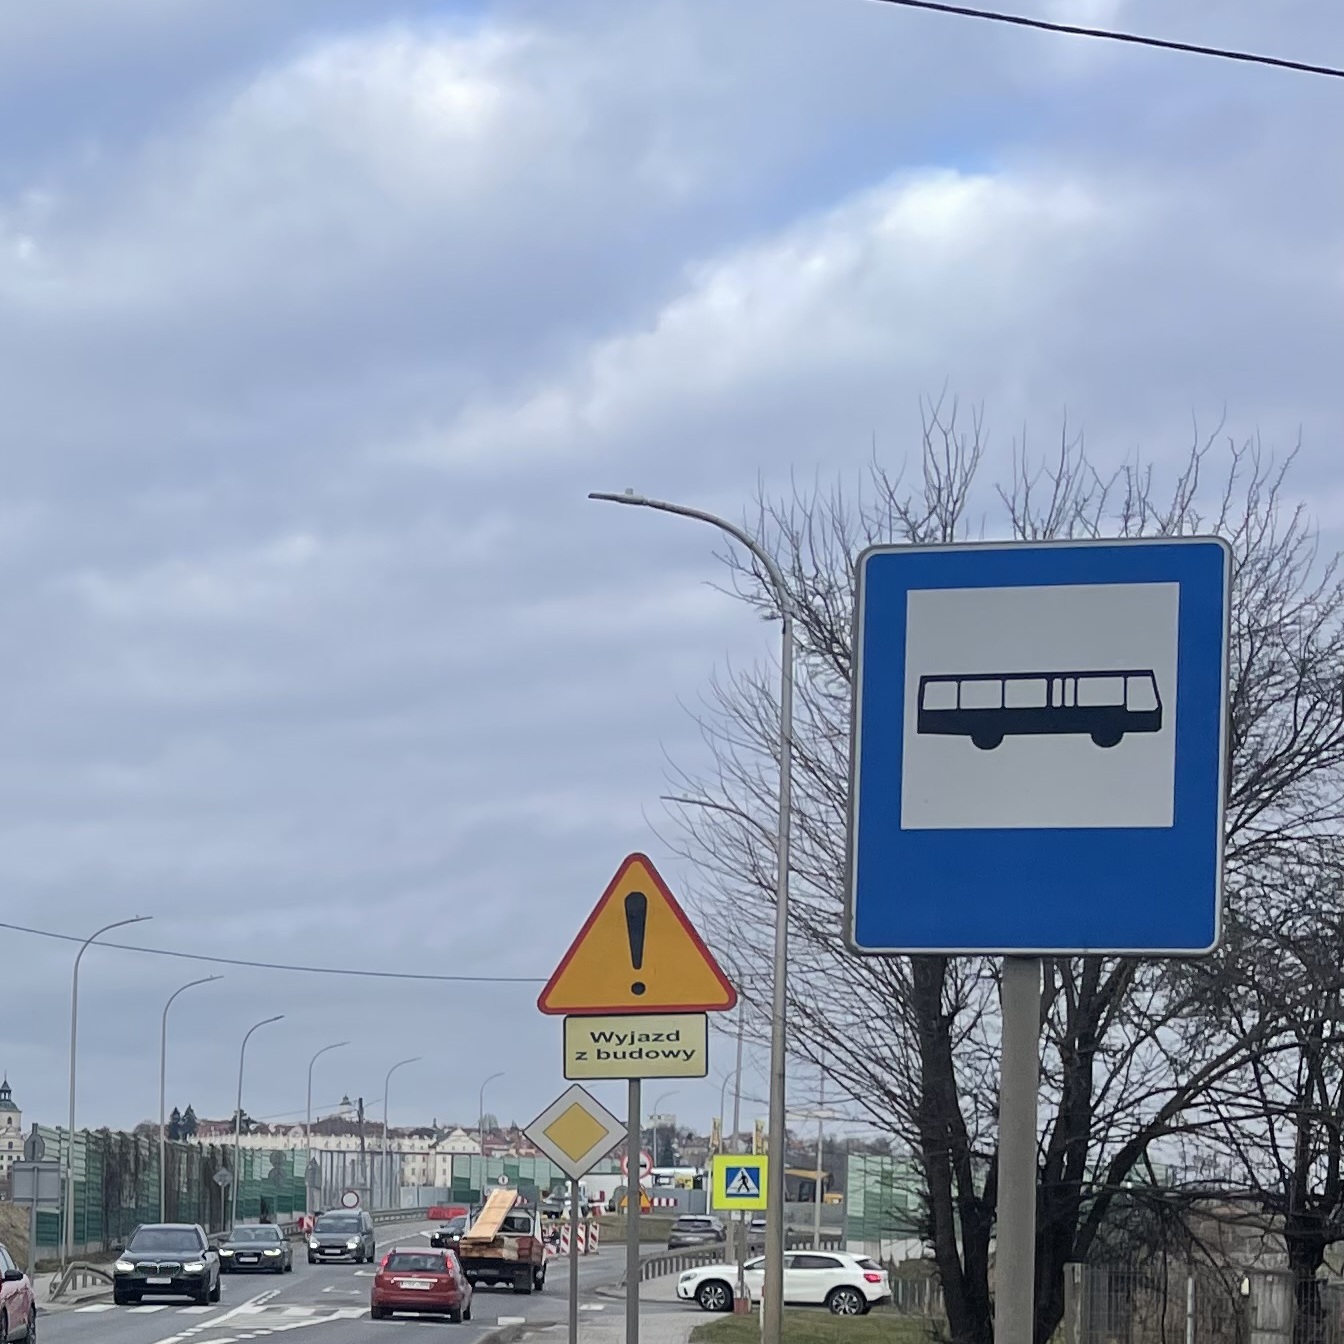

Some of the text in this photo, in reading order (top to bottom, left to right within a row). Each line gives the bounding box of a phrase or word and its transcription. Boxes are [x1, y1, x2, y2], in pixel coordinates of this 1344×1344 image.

[589, 1029, 681, 1046] Wyjazd
[575, 1047, 696, 1062] z budowy
